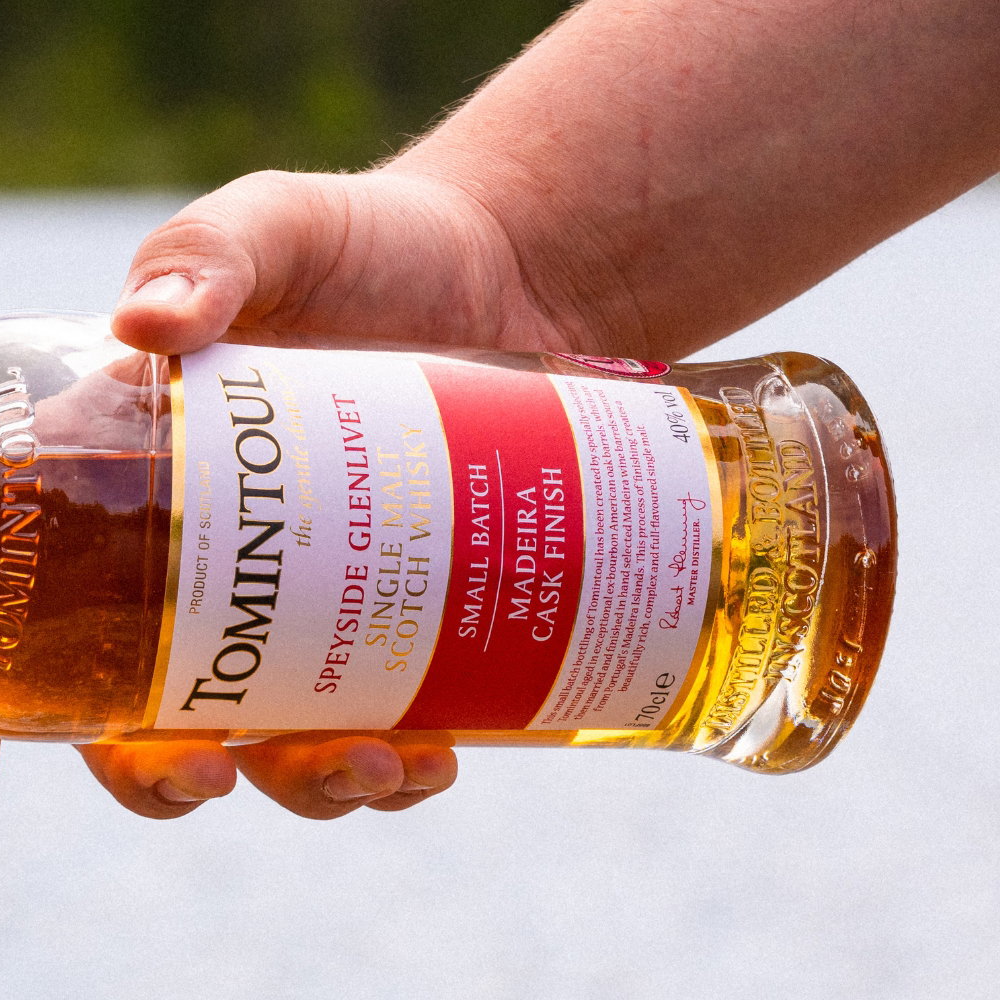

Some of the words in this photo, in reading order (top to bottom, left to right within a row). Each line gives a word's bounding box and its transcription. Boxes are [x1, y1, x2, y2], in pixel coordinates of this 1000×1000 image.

[565, 382, 584, 414] selecting
[580, 385, 593, 398] are
[586, 398, 602, 421] which
[594, 389, 614, 418] sourced
[654, 391, 678, 408] vol
[579, 414, 598, 453] specially
[608, 420, 624, 452] barrels
[618, 406, 634, 436] creates
[636, 423, 650, 446] malt.
[664, 412, 690, 443] 40%
[331, 393, 372, 551] GLENLIVET
[590, 454, 600, 466] by
[603, 459, 614, 478] oak
[618, 453, 628, 478] wine
[642, 448, 656, 476] single
[718, 386, 782, 525] BOTTLED
[198, 460, 212, 529] SCOTLAND
[287, 446, 322, 510] gentle
[376, 446, 404, 528] MALT
[399, 422, 432, 542] WHISKY
[590, 468, 603, 506] created
[634, 484, 644, 496] of
[468, 464, 490, 546] BATCH
[541, 467, 566, 560] FINISH
[608, 480, 618, 532] American
[621, 479, 632, 523] Madeira
[637, 497, 648, 538] process
[647, 478, 660, 550] full-flavoured
[178, 366, 286, 712] TOMINTOUL
[290, 516, 312, 548] the
[595, 509, 604, 534] been
[775, 438, 821, 639] SCOTLAND
[198, 533, 210, 550] OF
[508, 486, 538, 620] MADEIRA
[594, 536, 604, 556] has
[622, 524, 632, 568] selected
[636, 540, 646, 564] This
[691, 518, 700, 567] DISTILLER.
[762, 532, 785, 560] &
[606, 534, 618, 594] ex-bourbon
[650, 552, 660, 572] and
[188, 555, 209, 615] PRODUCT
[364, 542, 402, 647] SINGLE
[458, 556, 489, 638] SMALL
[587, 558, 604, 613] Tomintoul
[617, 570, 631, 598] hand
[630, 565, 645, 606] Islands.
[644, 574, 658, 619] complex
[686, 569, 698, 606] MASTER
[384, 556, 430, 672] SCOTCH
[531, 570, 564, 642] CASK
[586, 614, 596, 626] of
[616, 600, 626, 610] in
[313, 565, 369, 694] SPEYSIDE
[593, 596, 613, 654] exceptional
[606, 612, 624, 652] finished
[621, 607, 639, 648] Madeira
[638, 620, 651, 642] rich,
[572, 627, 595, 666] bottling
[588, 656, 599, 664] in
[601, 653, 614, 671] and
[699, 567, 780, 732] DISTILLED
[561, 668, 580, 690] batch
[580, 666, 596, 686] aged
[604, 650, 628, 692] Portugal's
[618, 644, 646, 692] beautifully
[553, 692, 570, 711] small
[557, 687, 586, 722] Tomintoul
[586, 672, 606, 704] married
[592, 693, 611, 712] from
[541, 712, 558, 724] This
[574, 705, 588, 720] then
